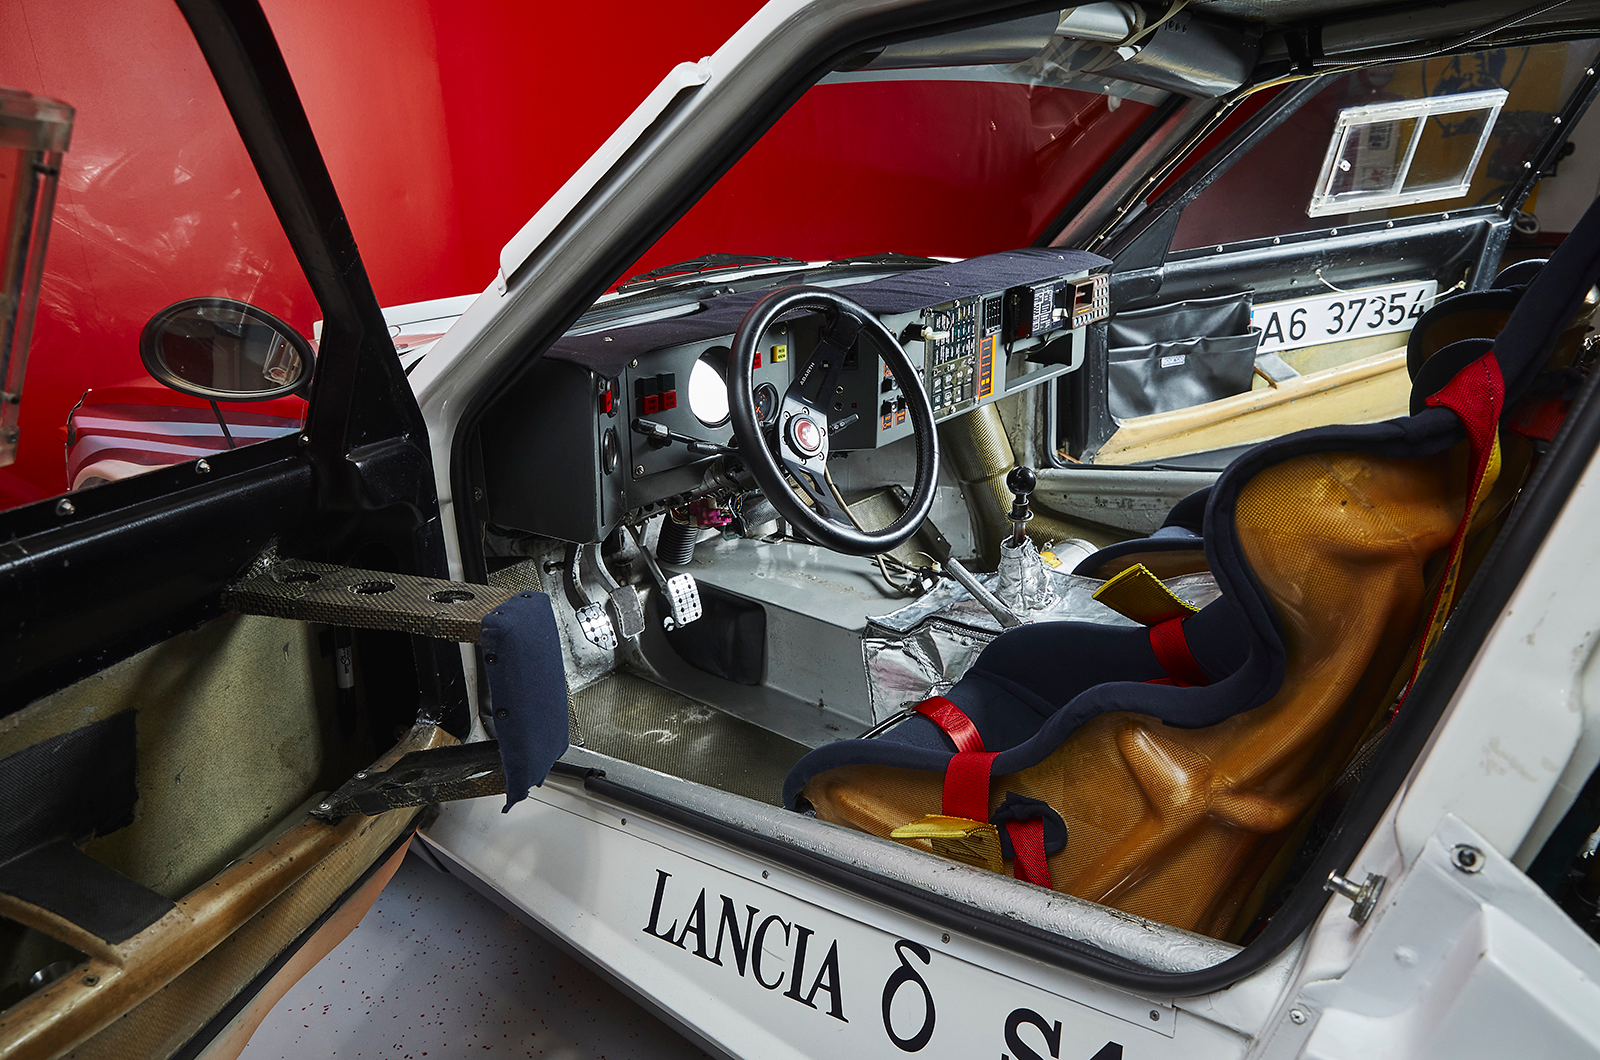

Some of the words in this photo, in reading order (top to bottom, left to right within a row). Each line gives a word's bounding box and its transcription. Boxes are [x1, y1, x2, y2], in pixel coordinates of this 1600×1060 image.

[1259, 308, 1307, 346] A6
[1326, 289, 1425, 335] 37354
[642, 868, 850, 1024] LANCIA
